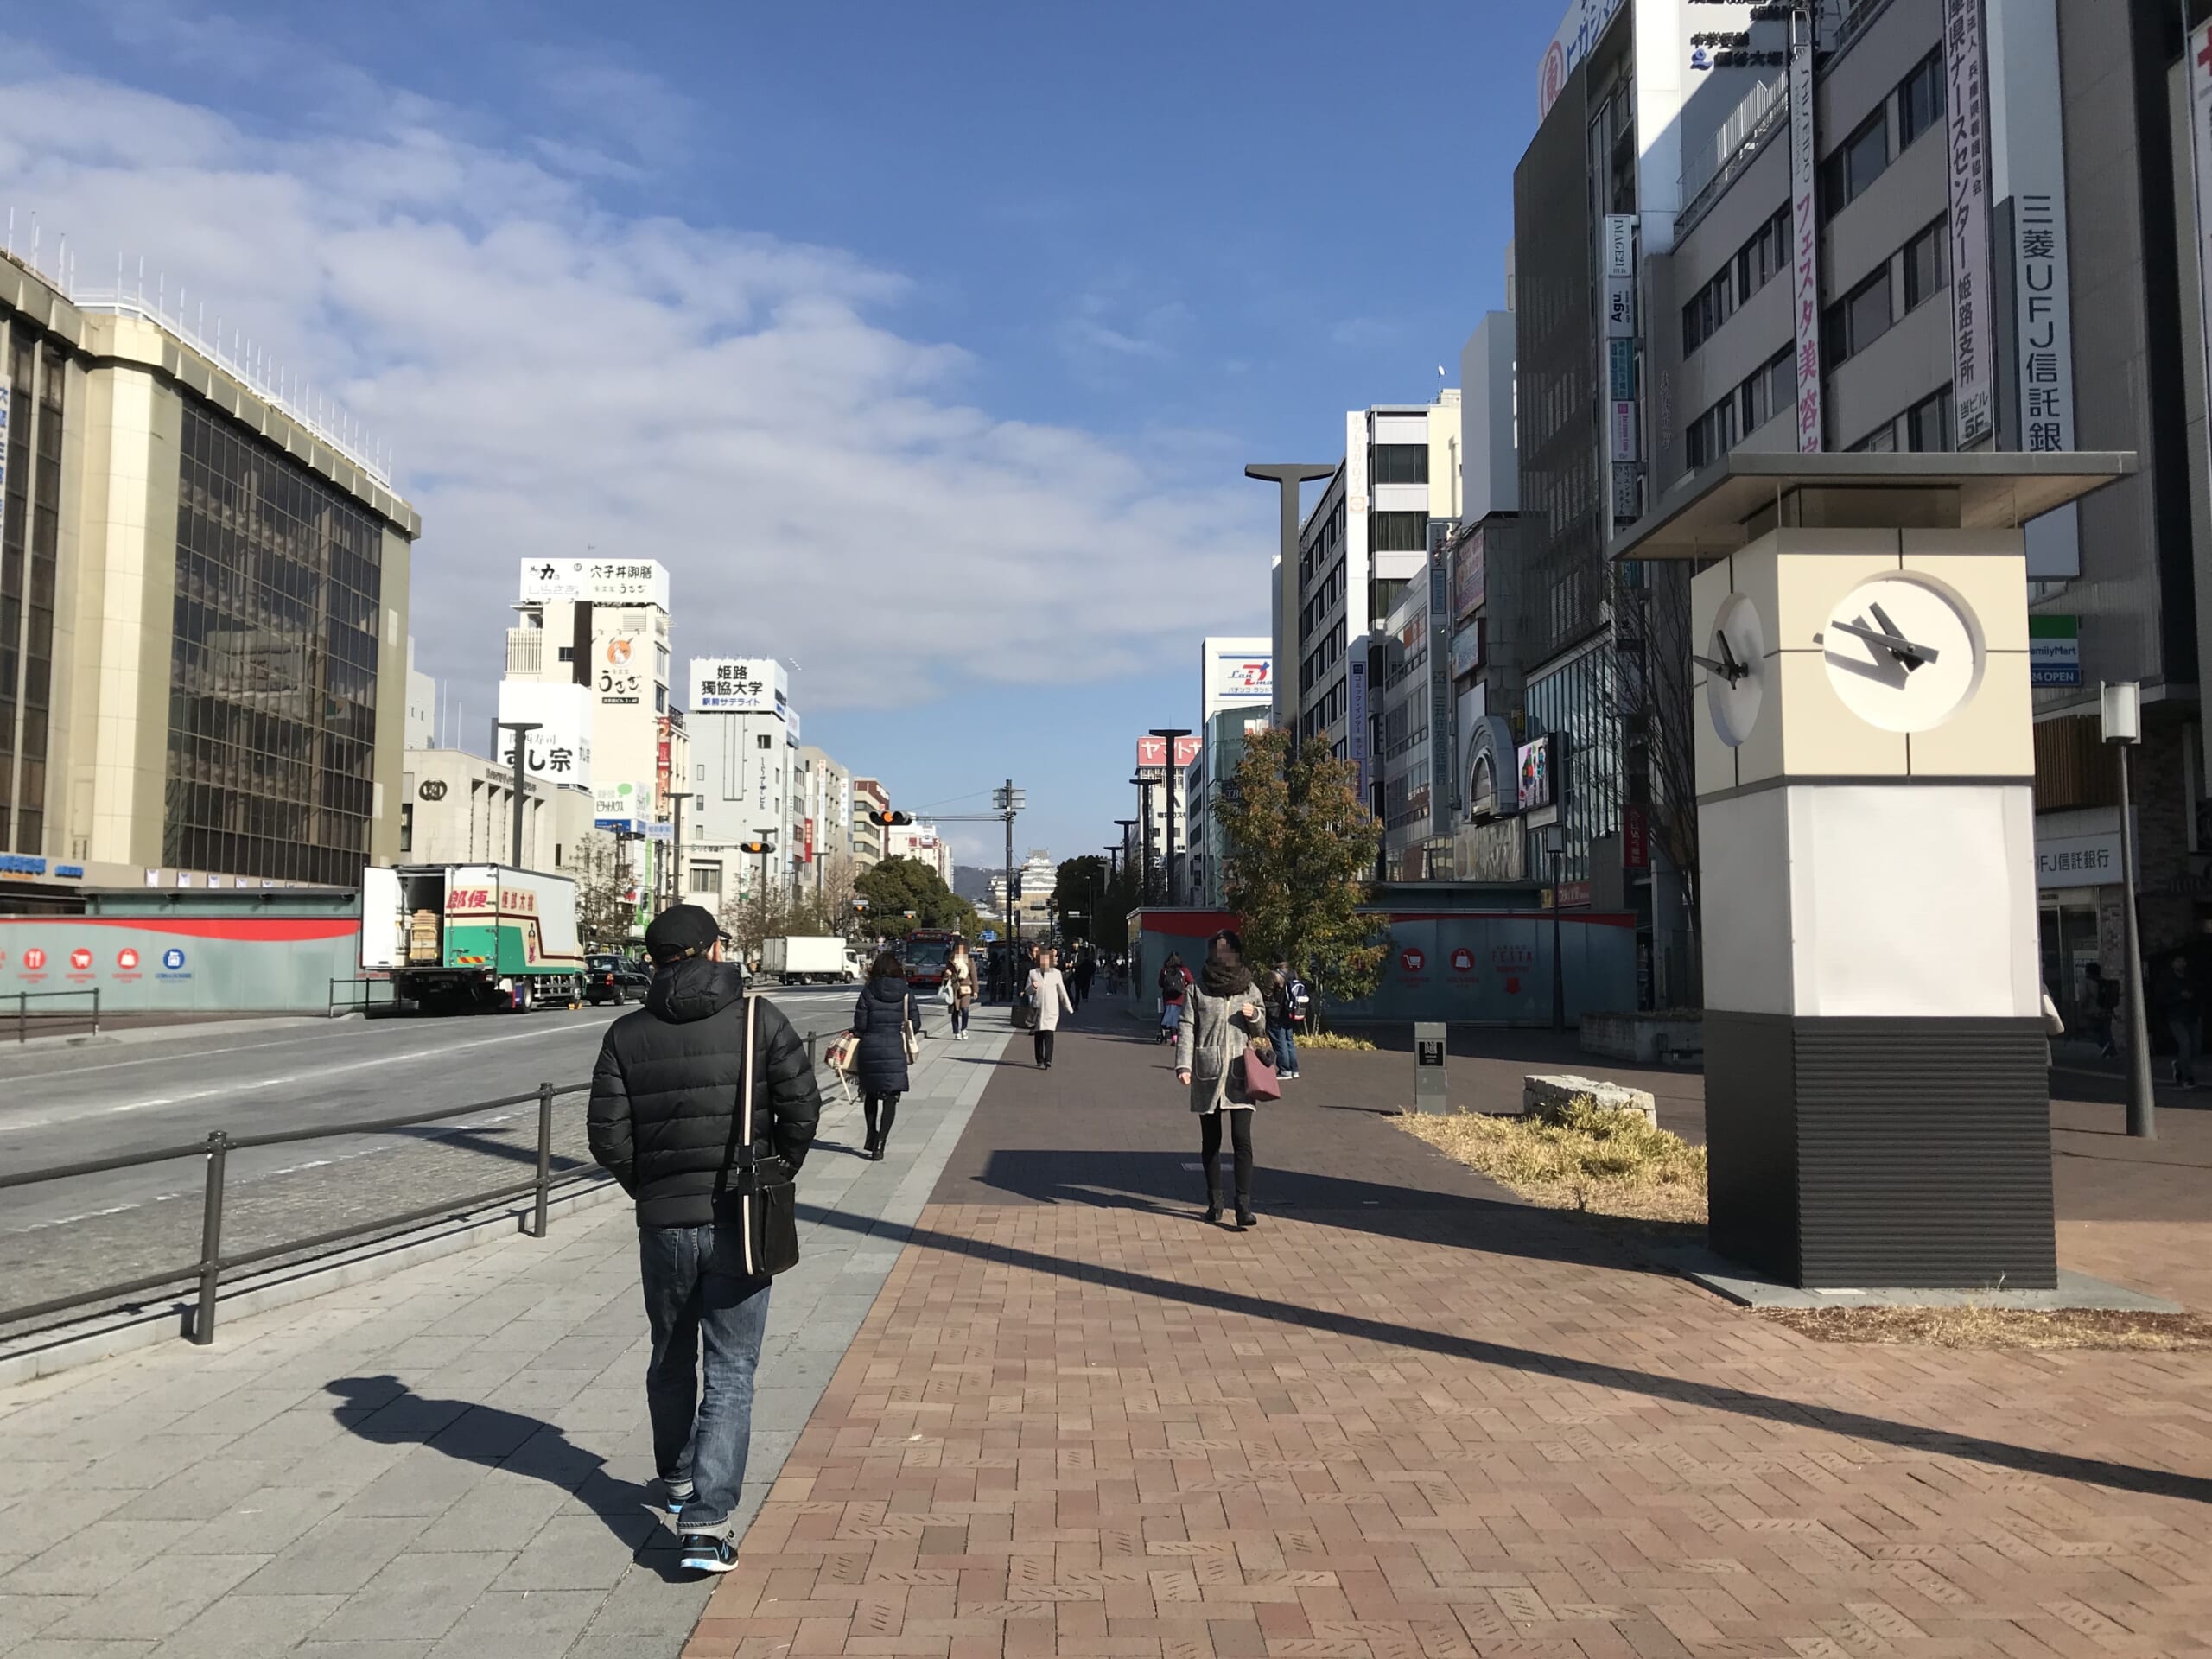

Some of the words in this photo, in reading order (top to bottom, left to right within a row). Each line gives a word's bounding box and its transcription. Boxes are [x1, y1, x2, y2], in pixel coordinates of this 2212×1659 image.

[1614, 219, 1625, 266] IMAGE21
[1611, 290, 1624, 323] Agu.
[1960, 391, 1988, 419] 当ビル
[1965, 411, 1985, 438] 5F
[590, 564, 652, 580] 穴子丼御膳
[717, 664, 748, 680] 姫路
[2044, 672, 2074, 682] OPEN
[598, 670, 643, 695] うさぎ
[702, 681, 763, 696] 獨協大学
[702, 698, 760, 707] 駅前サテライト
